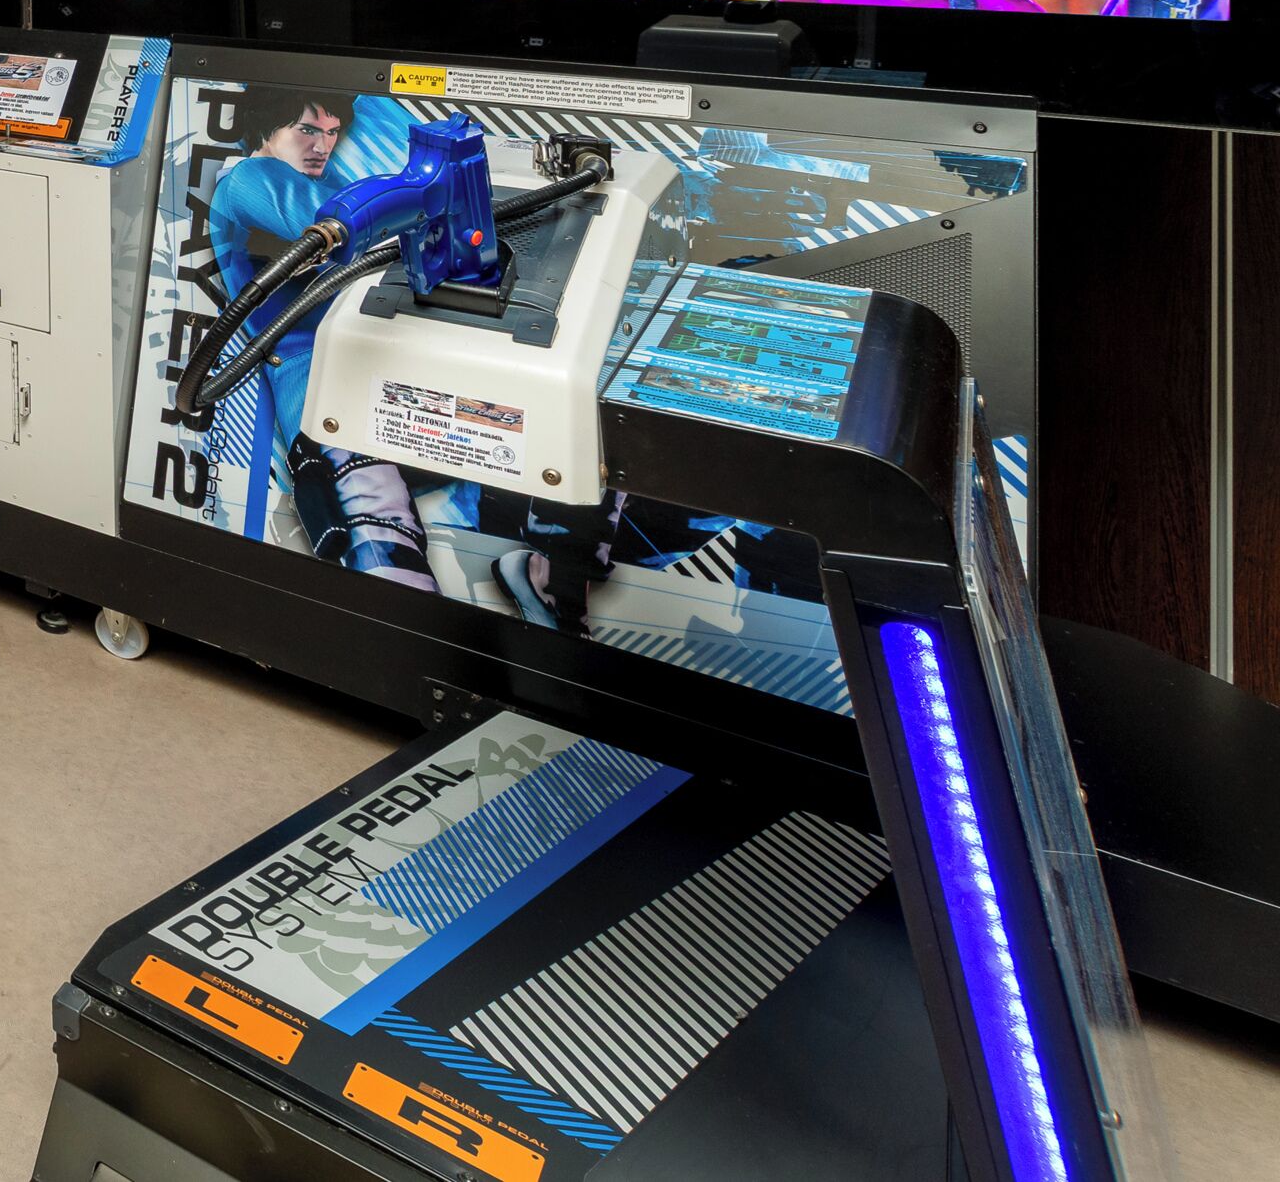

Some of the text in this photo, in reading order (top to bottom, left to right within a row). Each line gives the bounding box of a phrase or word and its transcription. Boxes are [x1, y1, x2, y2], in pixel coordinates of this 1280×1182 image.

[13, 65, 33, 79] 5
[408, 74, 445, 82] CAUTION
[657, 87, 684, 95] playing
[106, 65, 138, 142] PLAYER 2
[597, 94, 622, 102] playing
[653, 92, 674, 100] might
[744, 315, 829, 333] CONTROLS
[656, 361, 819, 394] TIPS FOR SUCCESS
[406, 410, 411, 420] 1
[152, 441, 209, 510] 2
[202, 427, 228, 521] Godart
[167, 763, 475, 951] DOUBLE PEDAL
[202, 853, 384, 971] SYSTEM
[184, 985, 239, 1030] L
[212, 976, 310, 1029] DOUBLE PEDAL
[398, 1095, 483, 1157] R
[431, 1088, 549, 1151] DOUBLE PEDAL
